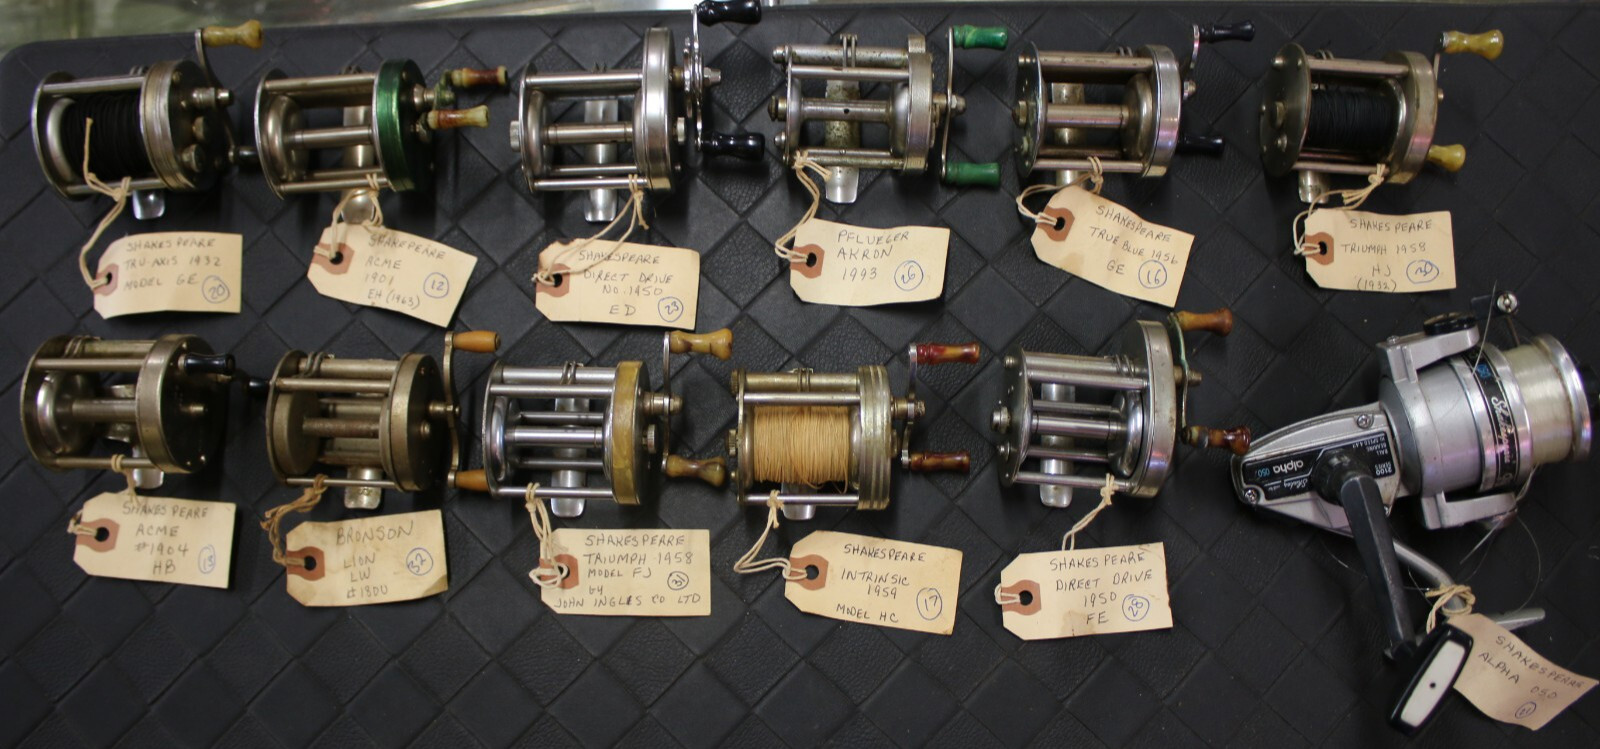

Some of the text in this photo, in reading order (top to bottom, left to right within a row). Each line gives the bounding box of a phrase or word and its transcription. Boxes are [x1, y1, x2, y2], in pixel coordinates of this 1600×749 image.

[1095, 204, 1172, 242] SHAKESPEARE
[837, 229, 910, 246] PFLUEGER
[1089, 225, 1120, 246] TRUE
[1121, 240, 1145, 257] BLUE
[836, 244, 893, 261] AKRON
[1341, 242, 1427, 256] TRIUMPH 1958
[189, 256, 222, 267] 1932
[365, 255, 402, 270] ACME
[1106, 259, 1126, 275] GE
[123, 273, 199, 291] MODEL GE
[364, 273, 394, 287] 1901
[583, 268, 674, 284] DIRECT DRIVE
[842, 266, 878, 282] 1993
[1146, 268, 1162, 285] 16
[208, 284, 226, 300] 20
[367, 288, 382, 300] EH
[609, 304, 636, 317] ED
[664, 301, 680, 316] 23
[1257, 459, 1304, 478] alpha 050
[136, 525, 180, 538] ACME
[336, 519, 414, 546] BRONSON
[134, 543, 189, 556] #1904
[843, 543, 927, 562] SHAKESPEARE
[344, 551, 376, 569] LION
[407, 552, 427, 573] 32
[583, 551, 694, 565] TRIUMPH 1958
[152, 560, 176, 575] HB
[350, 567, 372, 583] LW
[587, 567, 652, 579] MODEL FJ
[841, 568, 910, 587] INTRINSIC
[1055, 569, 1153, 591] DIRECT DRIVE
[867, 584, 898, 600] 1959
[1084, 591, 1117, 608] 1950
[554, 596, 584, 609] JOHN
[677, 593, 701, 604] LTD
[923, 595, 938, 612] 17
[1128, 599, 1144, 617] 28
[836, 603, 899, 623] MODEL HC
[1086, 611, 1109, 625] FE
[1478, 652, 1520, 684] ALPHA
